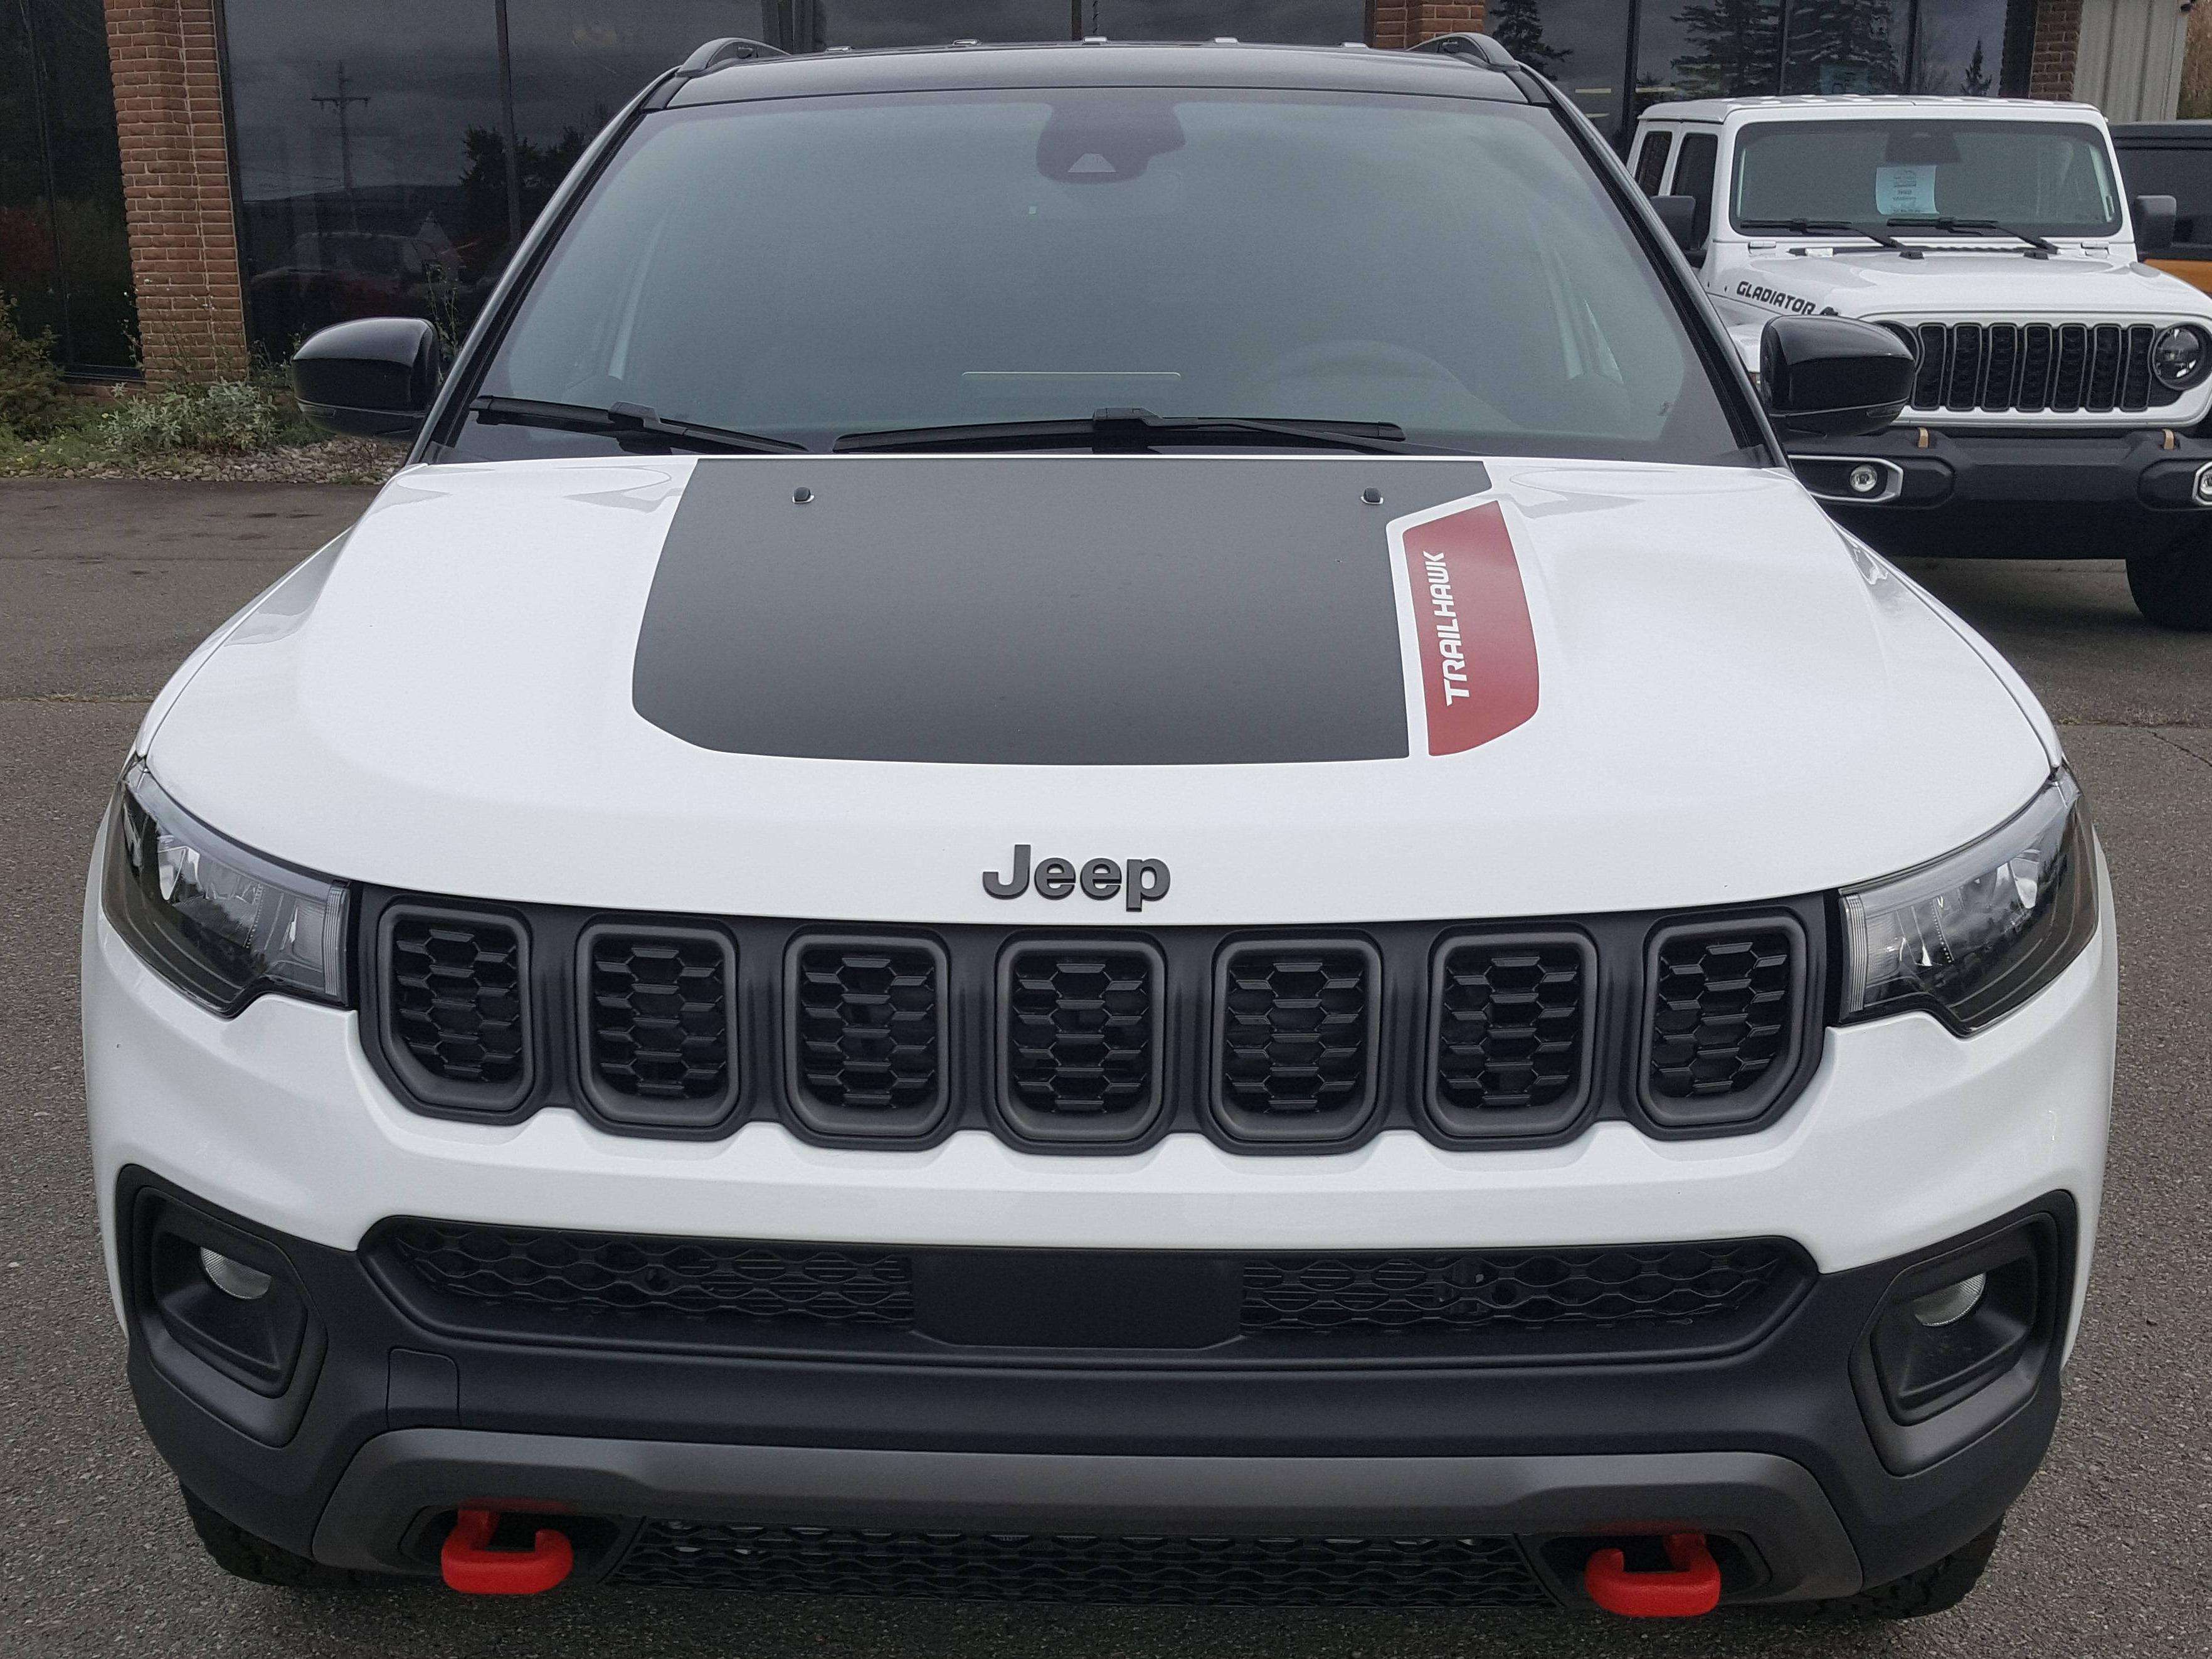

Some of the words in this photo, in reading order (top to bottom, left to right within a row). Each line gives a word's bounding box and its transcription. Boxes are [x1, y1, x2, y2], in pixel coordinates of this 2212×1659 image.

[1737, 281, 1816, 314] GLADIATOR
[1423, 551, 1470, 706] TRAILHAWK
[982, 844, 1171, 912] Jeep
